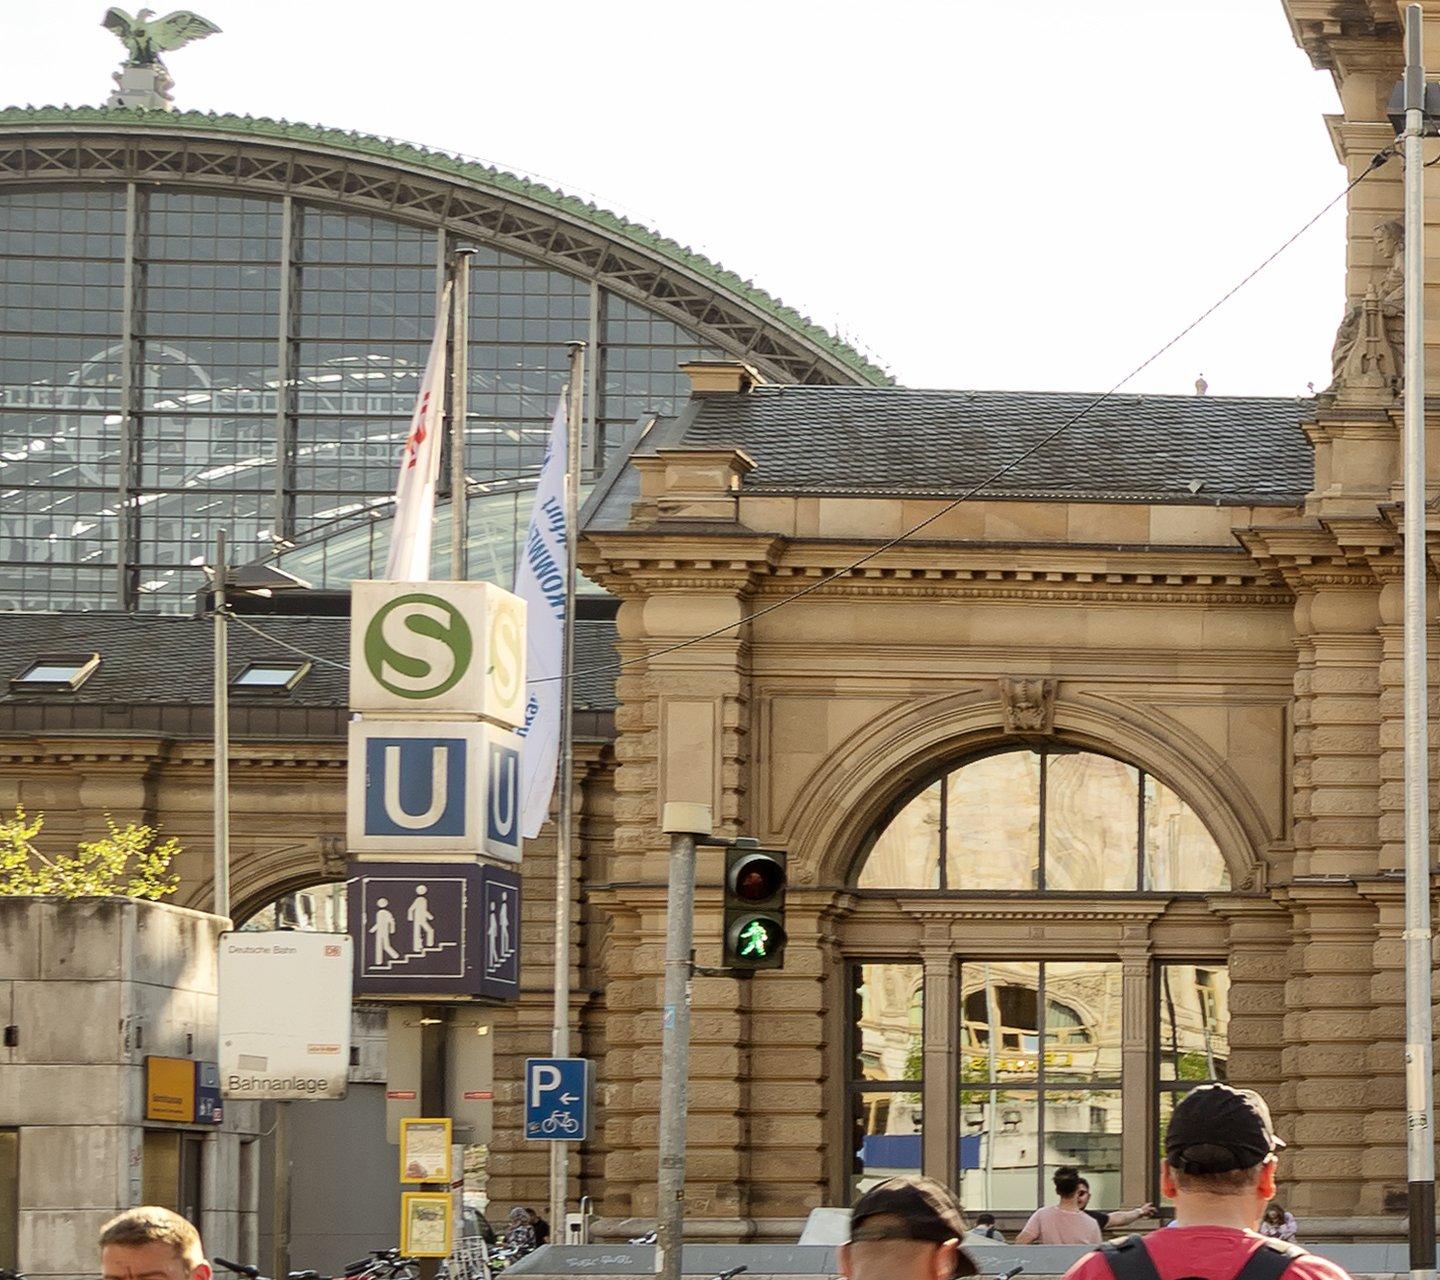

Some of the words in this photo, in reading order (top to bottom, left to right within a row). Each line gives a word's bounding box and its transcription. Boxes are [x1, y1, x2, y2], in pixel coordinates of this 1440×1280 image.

[381, 602, 456, 691] S
[384, 746, 448, 830] U
[493, 752, 515, 836] U
[229, 1075, 328, 1094] Bahnanlage
[532, 1065, 562, 1108] P
